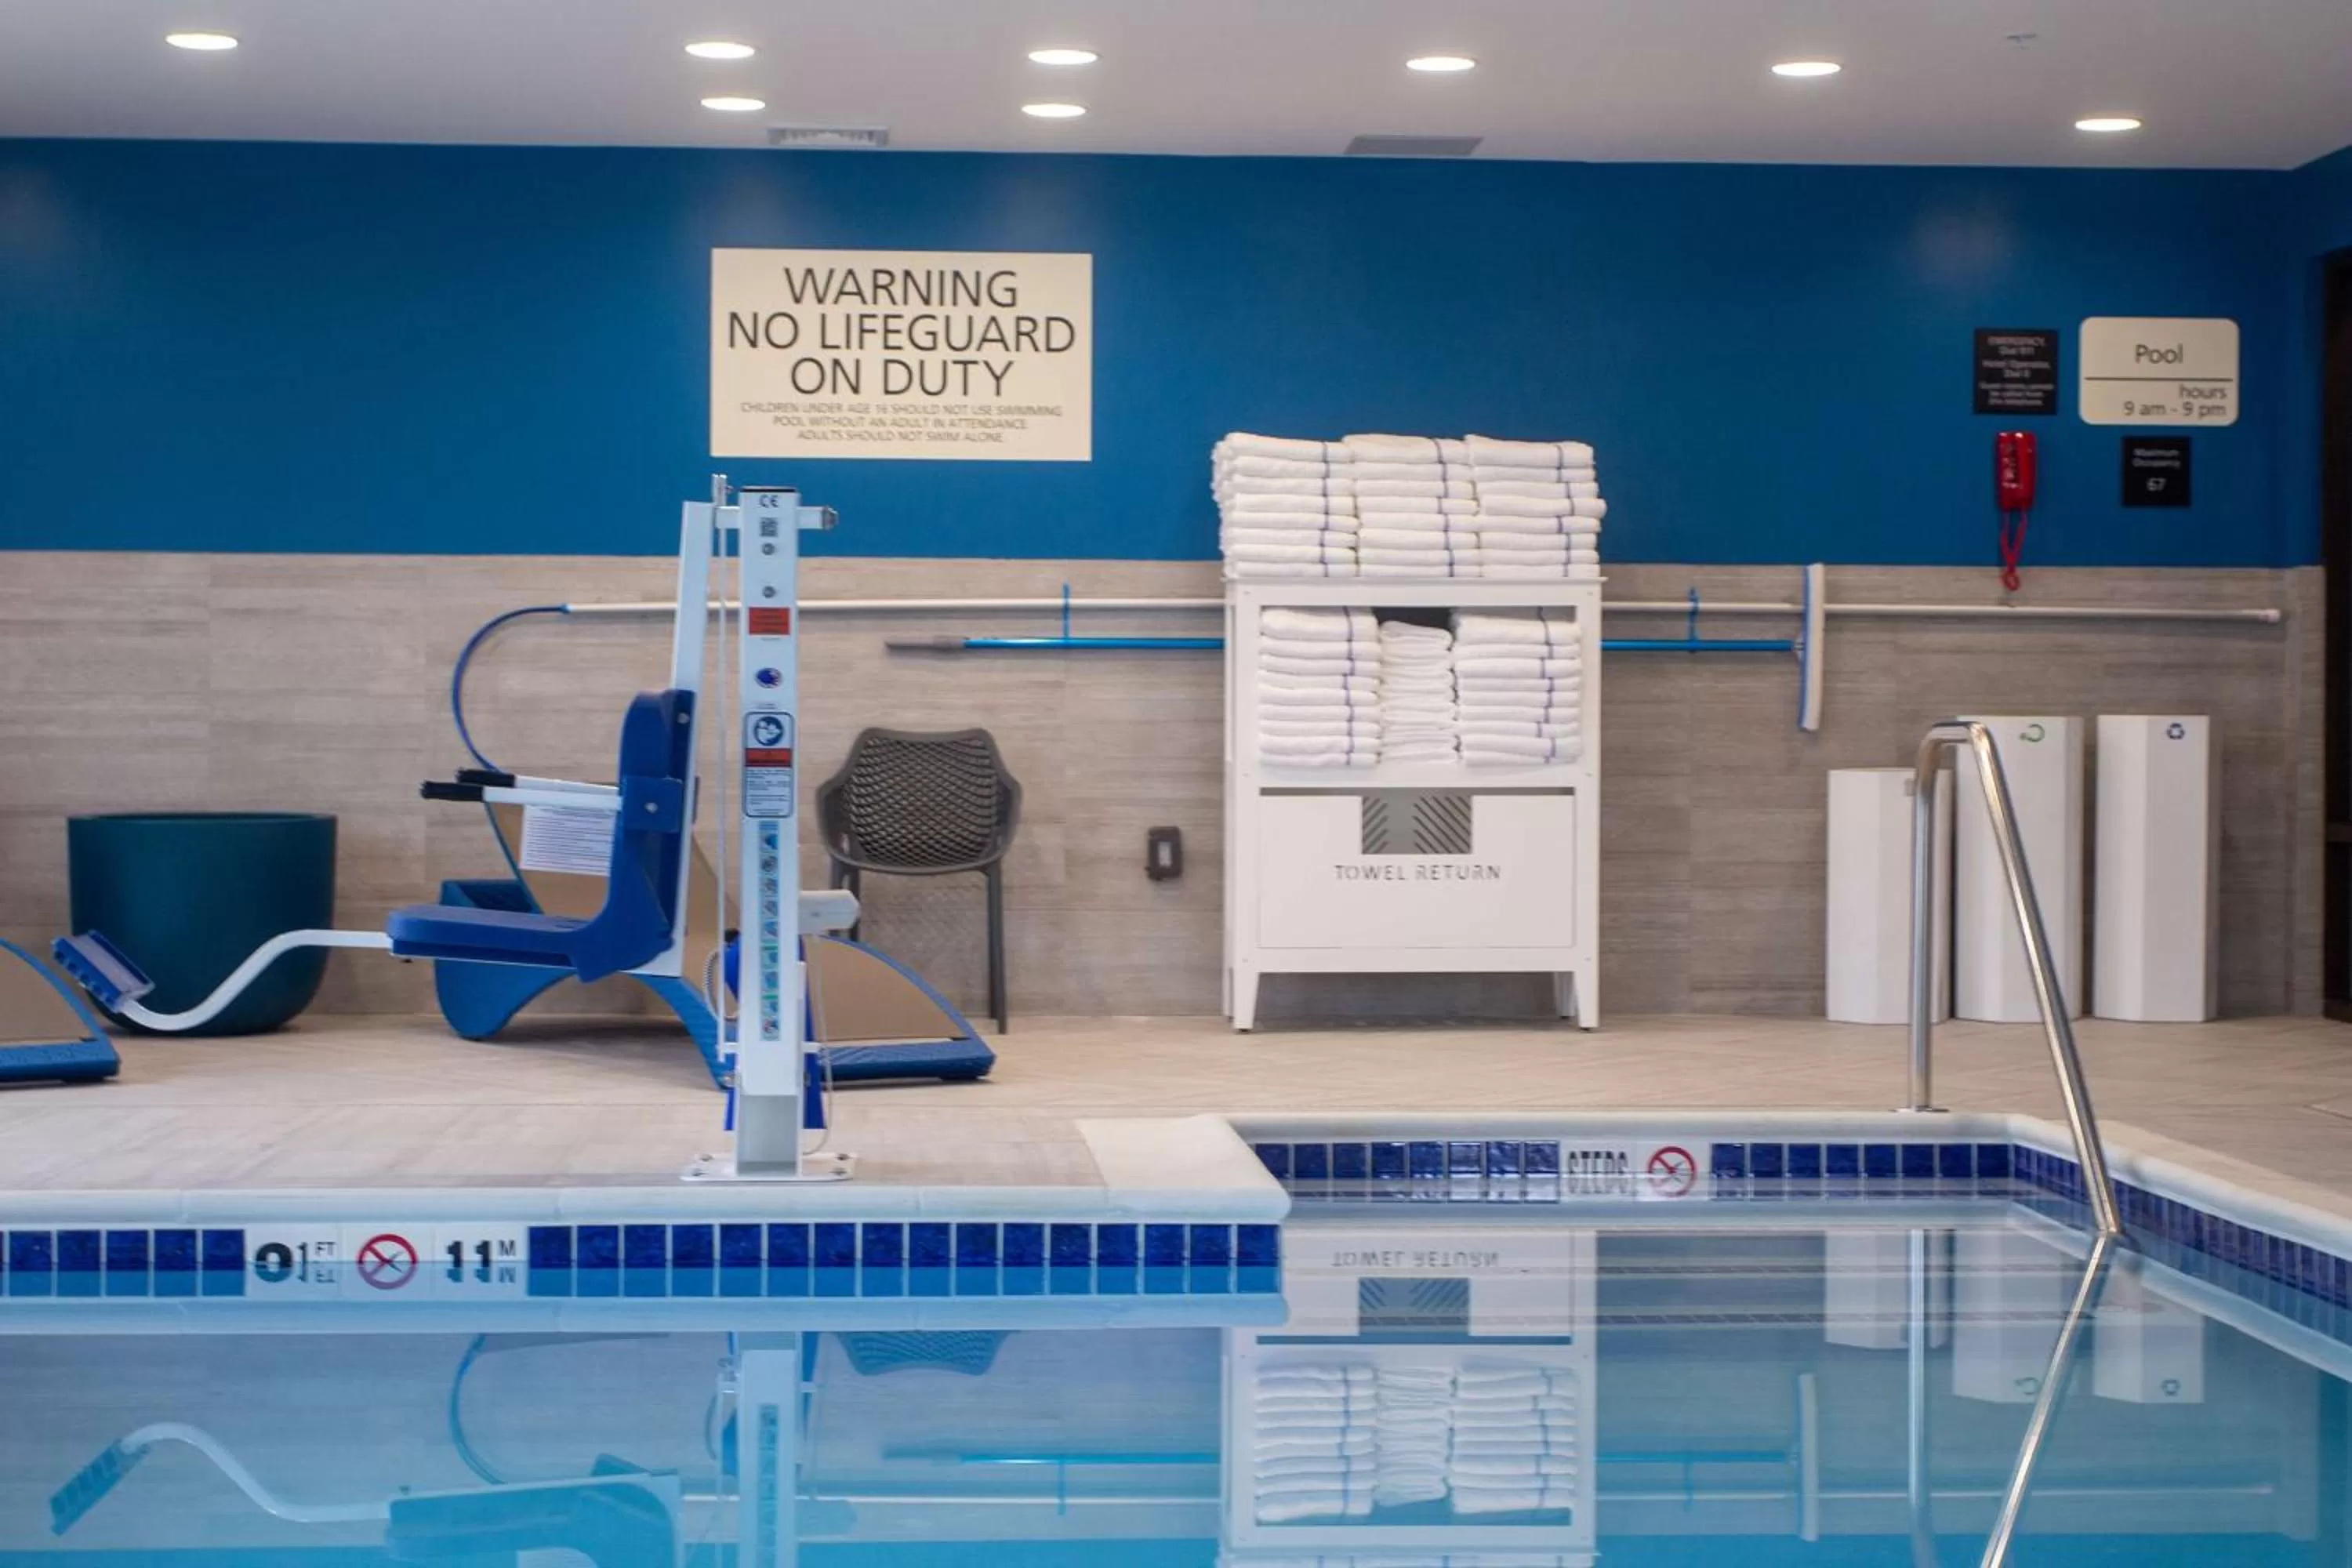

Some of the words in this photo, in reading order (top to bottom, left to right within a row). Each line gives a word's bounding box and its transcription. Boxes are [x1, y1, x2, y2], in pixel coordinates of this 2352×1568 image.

[784, 267, 1018, 307] WARNING
[729, 311, 799, 349] NO
[820, 314, 1076, 352] LIFEGUARD
[2134, 343, 2183, 365] Pool
[791, 358, 861, 394] ON
[884, 359, 1014, 396] DUTY
[2179, 383, 2227, 399] hours
[2123, 401, 2135, 416] 9
[2139, 404, 2167, 416] am
[2183, 401, 2194, 416] 9
[2198, 405, 2227, 419] pm
[1334, 865, 1408, 880] TOWEL
[1416, 865, 1501, 880] RETURN
